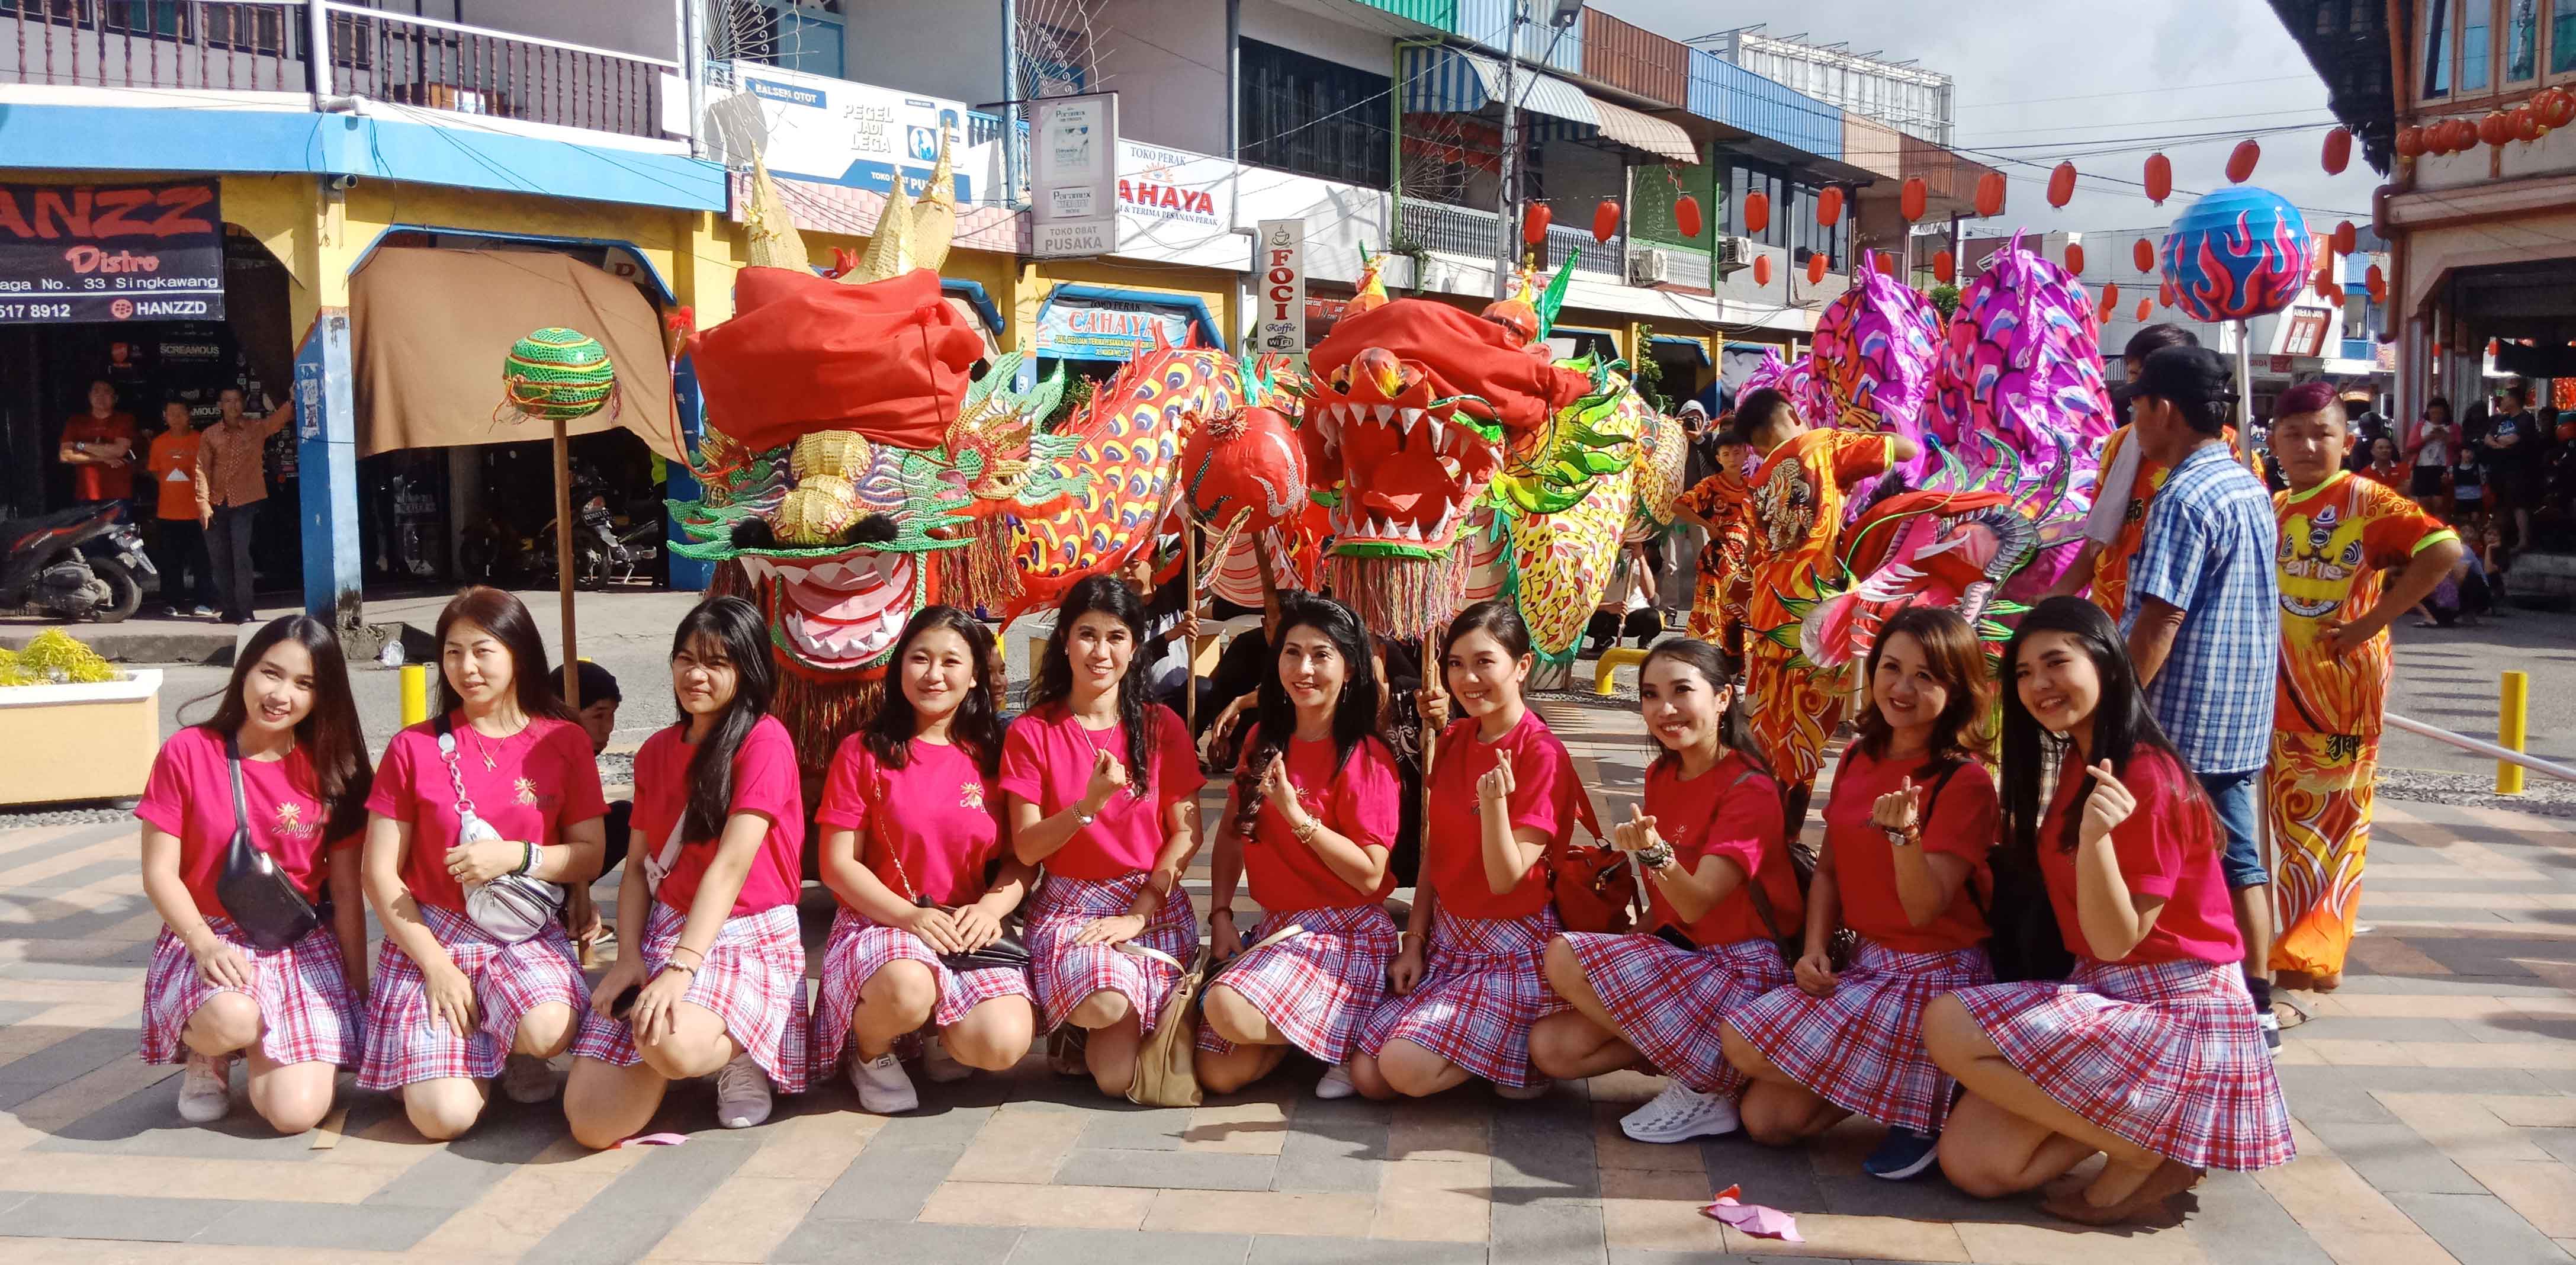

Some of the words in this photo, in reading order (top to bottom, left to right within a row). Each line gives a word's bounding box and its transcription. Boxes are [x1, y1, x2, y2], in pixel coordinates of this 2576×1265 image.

[793, 91, 817, 103] OTOT
[843, 104, 894, 123] PEGEL
[857, 121, 883, 136] JADI
[850, 134, 891, 153] LEGA
[1130, 146, 1155, 160] TOKO
[1158, 152, 1186, 166] PERAK
[871, 171, 891, 181] TOKO
[1132, 206, 1160, 217] TERIMA
[1162, 211, 1194, 223] PESANAN
[1195, 216, 1218, 226] PERAK
[1049, 227, 1072, 236] TOKO
[1075, 226, 1098, 235] OBAT
[1045, 237, 1103, 251] PUSAKA
[65, 245, 159, 273] Distro
[41, 278, 70, 290] No.
[84, 278, 105, 290] 33
[115, 277, 219, 289] Singkawang
[30, 304, 70, 318] 8912
[137, 301, 207, 316] HANZZD
[1068, 311, 1155, 336] CAHAYA
[1265, 323, 1296, 335] Koffie
[191, 407, 221, 416] MOUS
